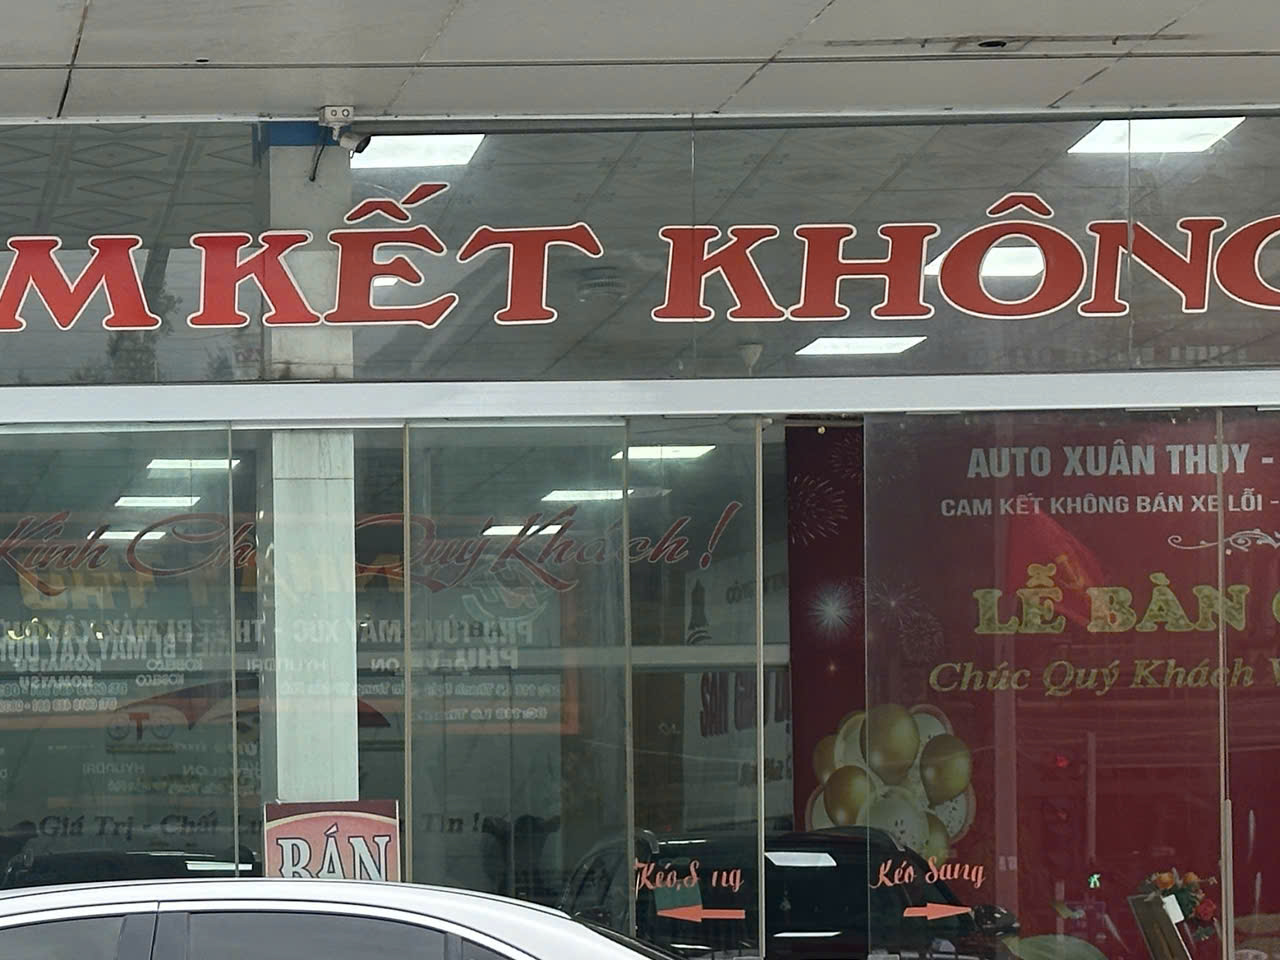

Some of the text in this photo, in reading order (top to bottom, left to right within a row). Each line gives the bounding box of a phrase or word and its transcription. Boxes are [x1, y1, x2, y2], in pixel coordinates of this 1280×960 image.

[186, 180, 605, 333] KẾT
[966, 445, 1052, 478] AUTO
[1062, 439, 1156, 476] XUÂN
[940, 498, 992, 517] CAM
[999, 491, 1045, 516] KẾT
[1050, 490, 1130, 515] KHÔNG
[1136, 493, 1184, 514] BÁN
[1191, 495, 1220, 513] XE
[1228, 487, 1263, 512] LỖI
[972, 562, 1066, 635] LỄ
[1085, 572, 1251, 635] BÀN
[928, 660, 1031, 693] Chúc
[1041, 660, 1121, 697] Quý
[1129, 657, 1256, 690] Khách
[39, 814, 86, 838] Giá
[276, 821, 392, 882] BÁN
[682, 858, 745, 893] Sng
[869, 854, 986, 890] Kéo Sang
